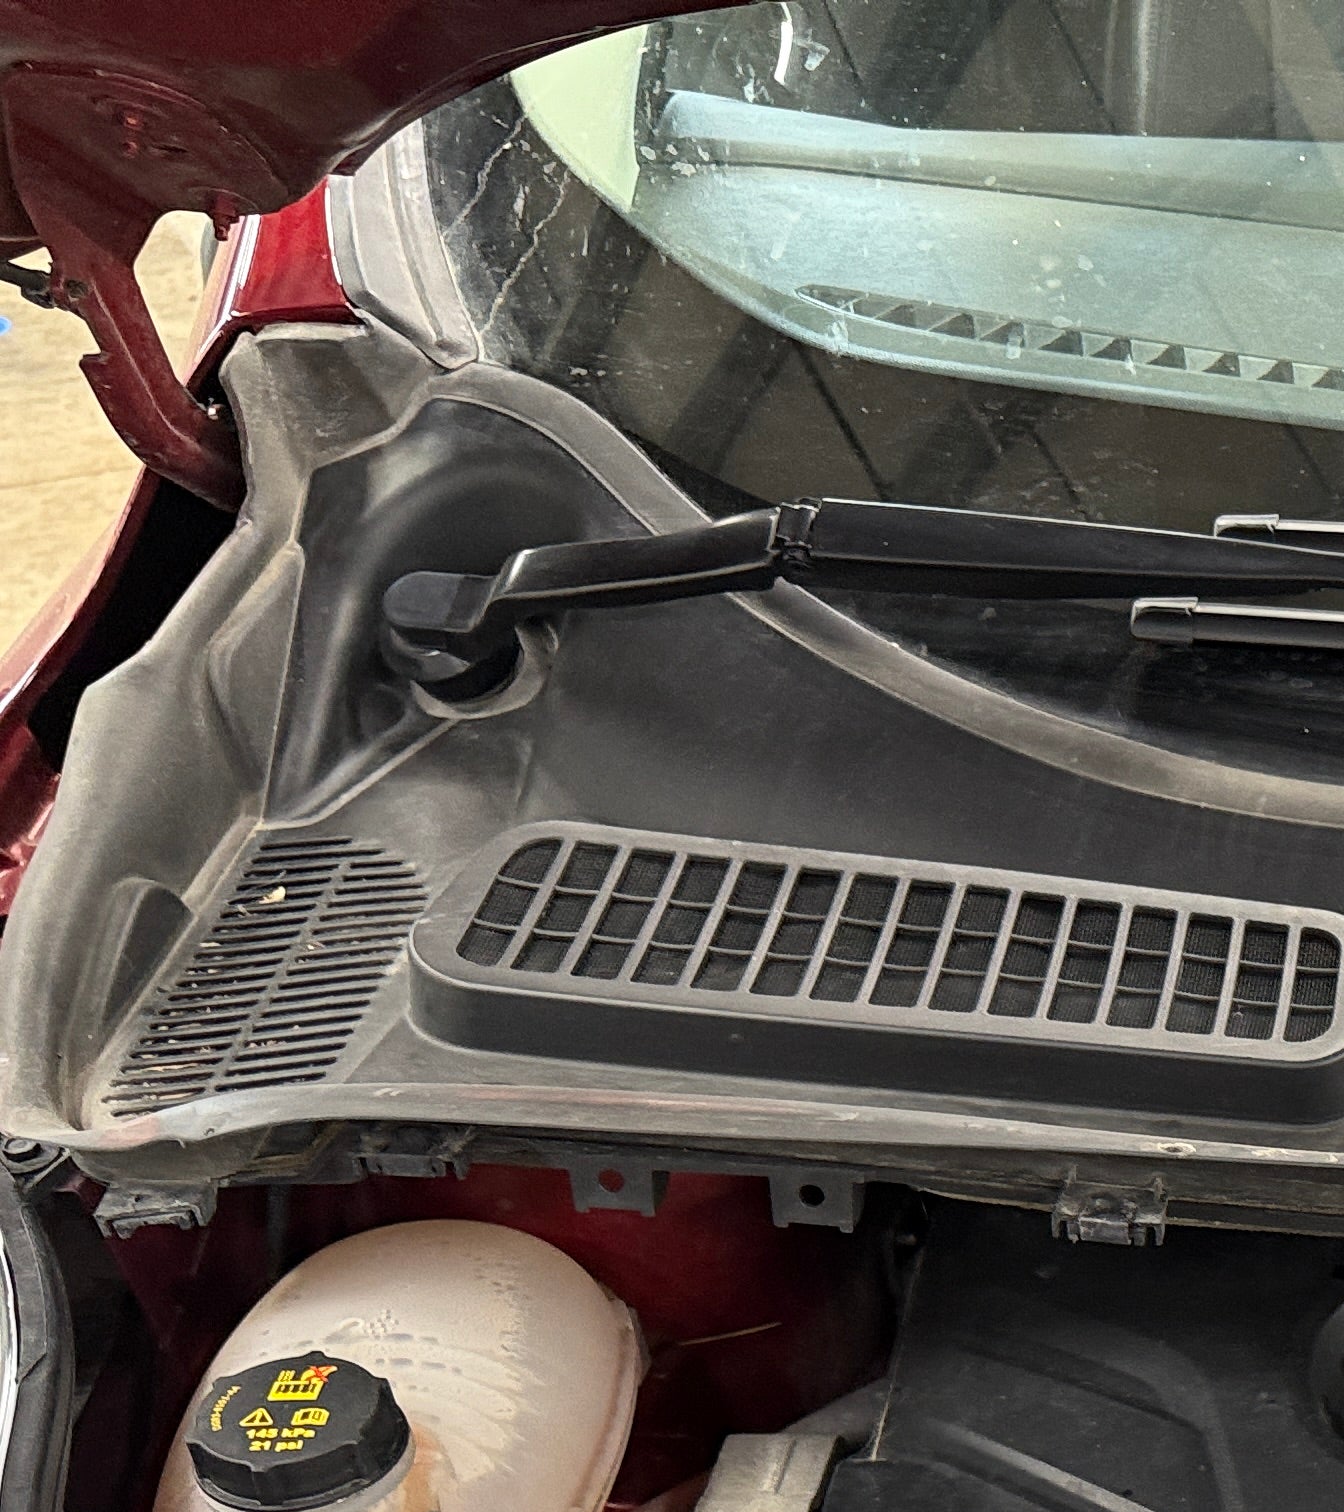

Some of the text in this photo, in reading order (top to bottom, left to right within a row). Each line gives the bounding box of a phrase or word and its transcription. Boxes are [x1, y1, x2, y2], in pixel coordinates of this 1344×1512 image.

[281, 1427, 316, 1438] kPa
[249, 1440, 304, 1453] 21 psi
